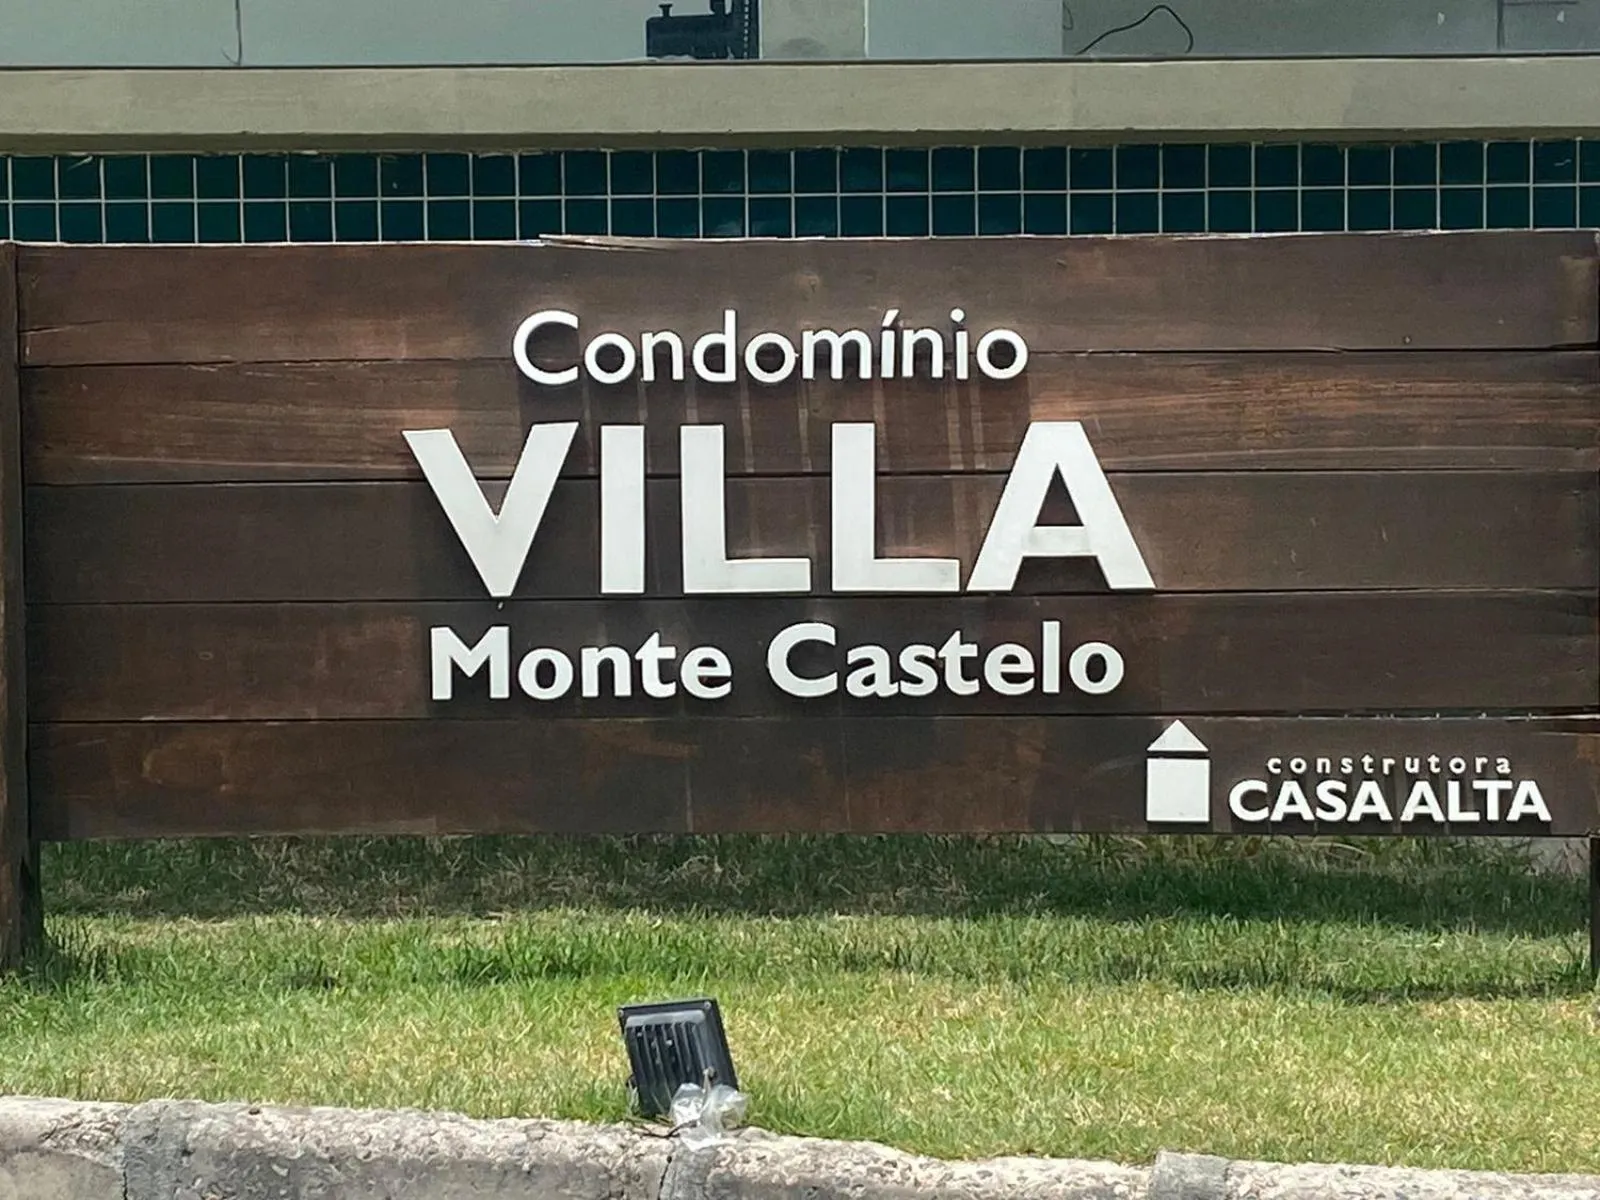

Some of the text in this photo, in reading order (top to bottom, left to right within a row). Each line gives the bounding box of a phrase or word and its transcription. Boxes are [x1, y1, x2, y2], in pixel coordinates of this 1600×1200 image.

[512, 308, 1028, 387] Condomínio
[402, 420, 1156, 598] VILLA
[429, 620, 1125, 701] Monte Castelo
[1228, 779, 1552, 823] CASA ALTA
[1266, 754, 1512, 775] construtora
